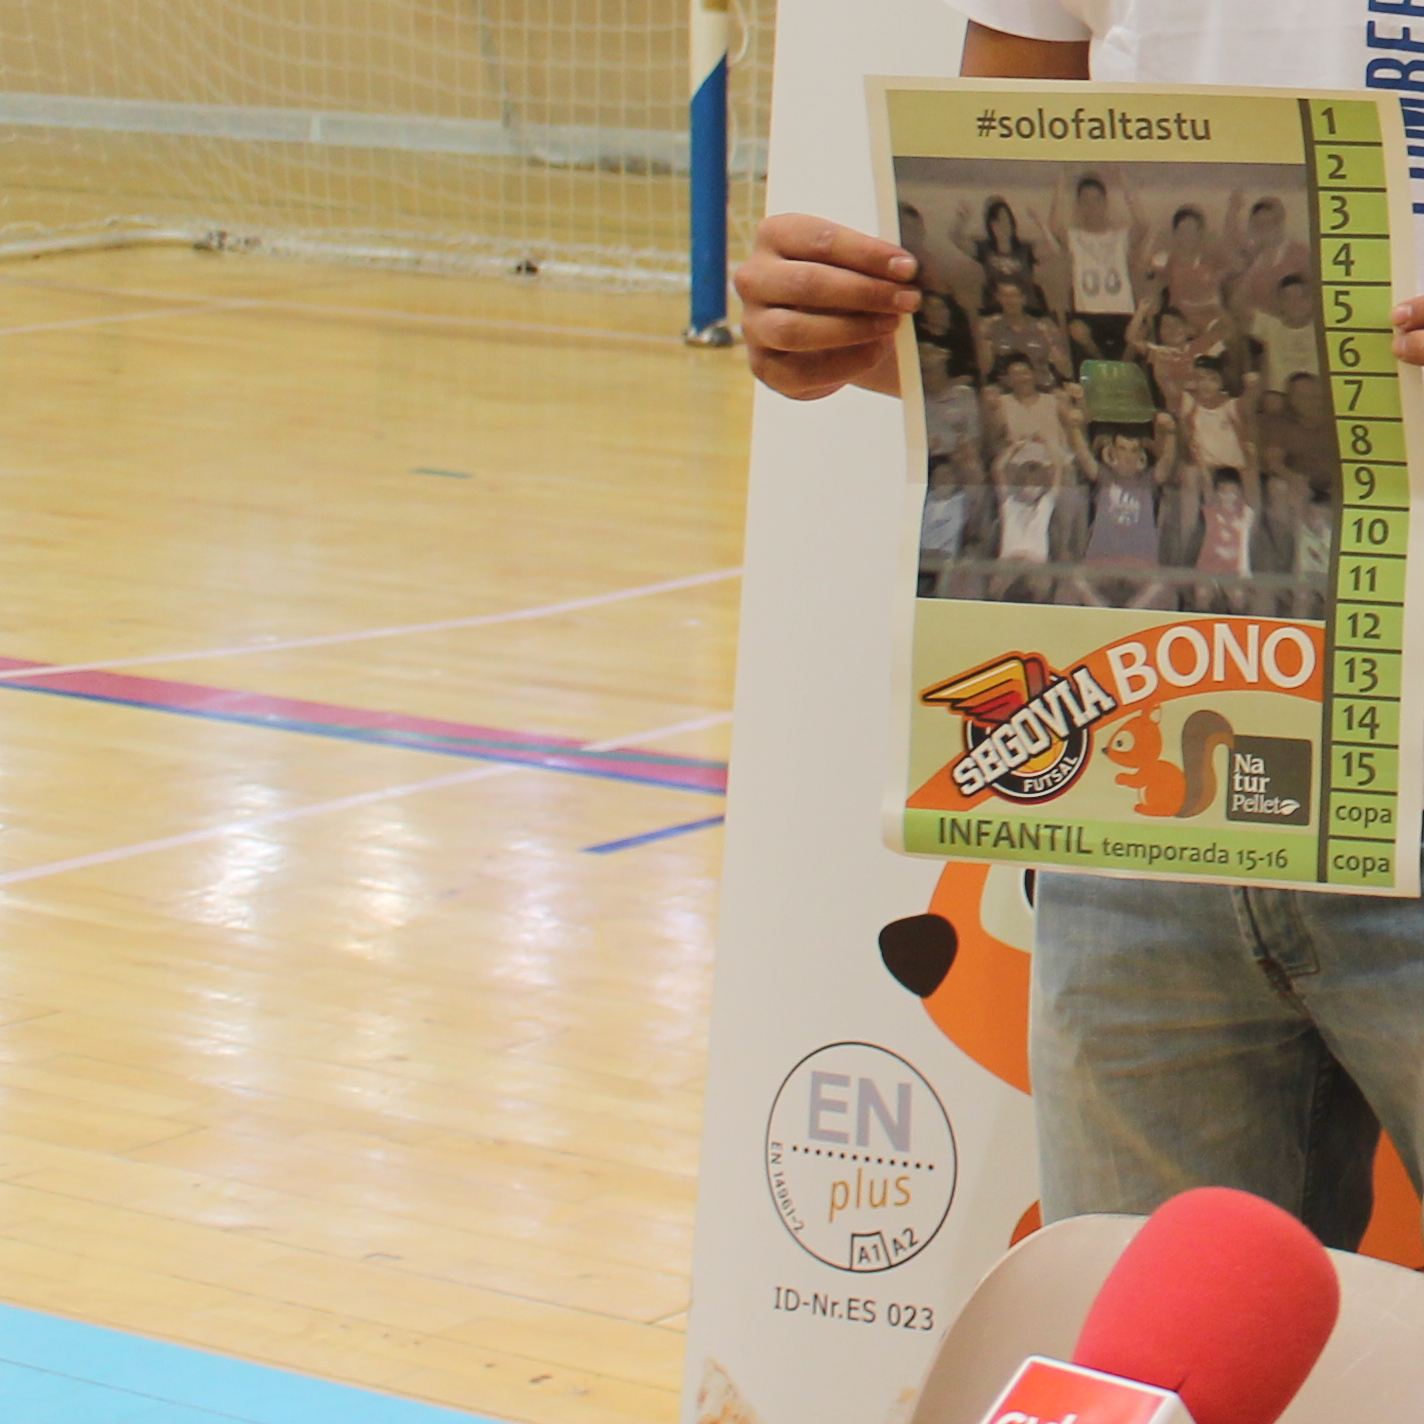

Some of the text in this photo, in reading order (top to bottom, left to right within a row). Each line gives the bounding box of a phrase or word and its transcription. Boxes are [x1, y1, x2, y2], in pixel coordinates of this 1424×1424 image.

[975, 106, 1213, 143] #solofaltastu
[1321, 107, 1336, 134] 1
[1327, 154, 1347, 179] 2
[1330, 196, 1349, 230] 3
[1332, 243, 1355, 276] 4
[1335, 291, 1353, 323] 5
[1339, 337, 1360, 367] 6
[1344, 380, 1363, 411] 7
[1352, 425, 1372, 455] 8
[1354, 467, 1375, 499] 9
[1352, 517, 1389, 546] 10
[1350, 565, 1377, 592] 11
[1347, 612, 1382, 639] 12
[1106, 623, 1316, 706] BONO
[1344, 657, 1379, 692] 13
[951, 667, 1115, 797] SEGOVIA
[1342, 704, 1380, 739] 14
[1022, 755, 1080, 794] FUTSAL
[1232, 753, 1265, 775] Na
[1341, 751, 1376, 786] 15
[1233, 773, 1270, 794] tur
[1232, 793, 1283, 815] Pellet
[1335, 804, 1392, 828] copa
[938, 816, 1288, 871] INFANTIL temporada 15-16
[1333, 853, 1390, 877] copa
[808, 1070, 913, 1154] EN
[770, 1140, 783, 1165] EN
[829, 1167, 912, 1223] plus
[857, 1227, 920, 1264] A1 A2
[773, 1285, 935, 1332] ID-Nr.ES 023
